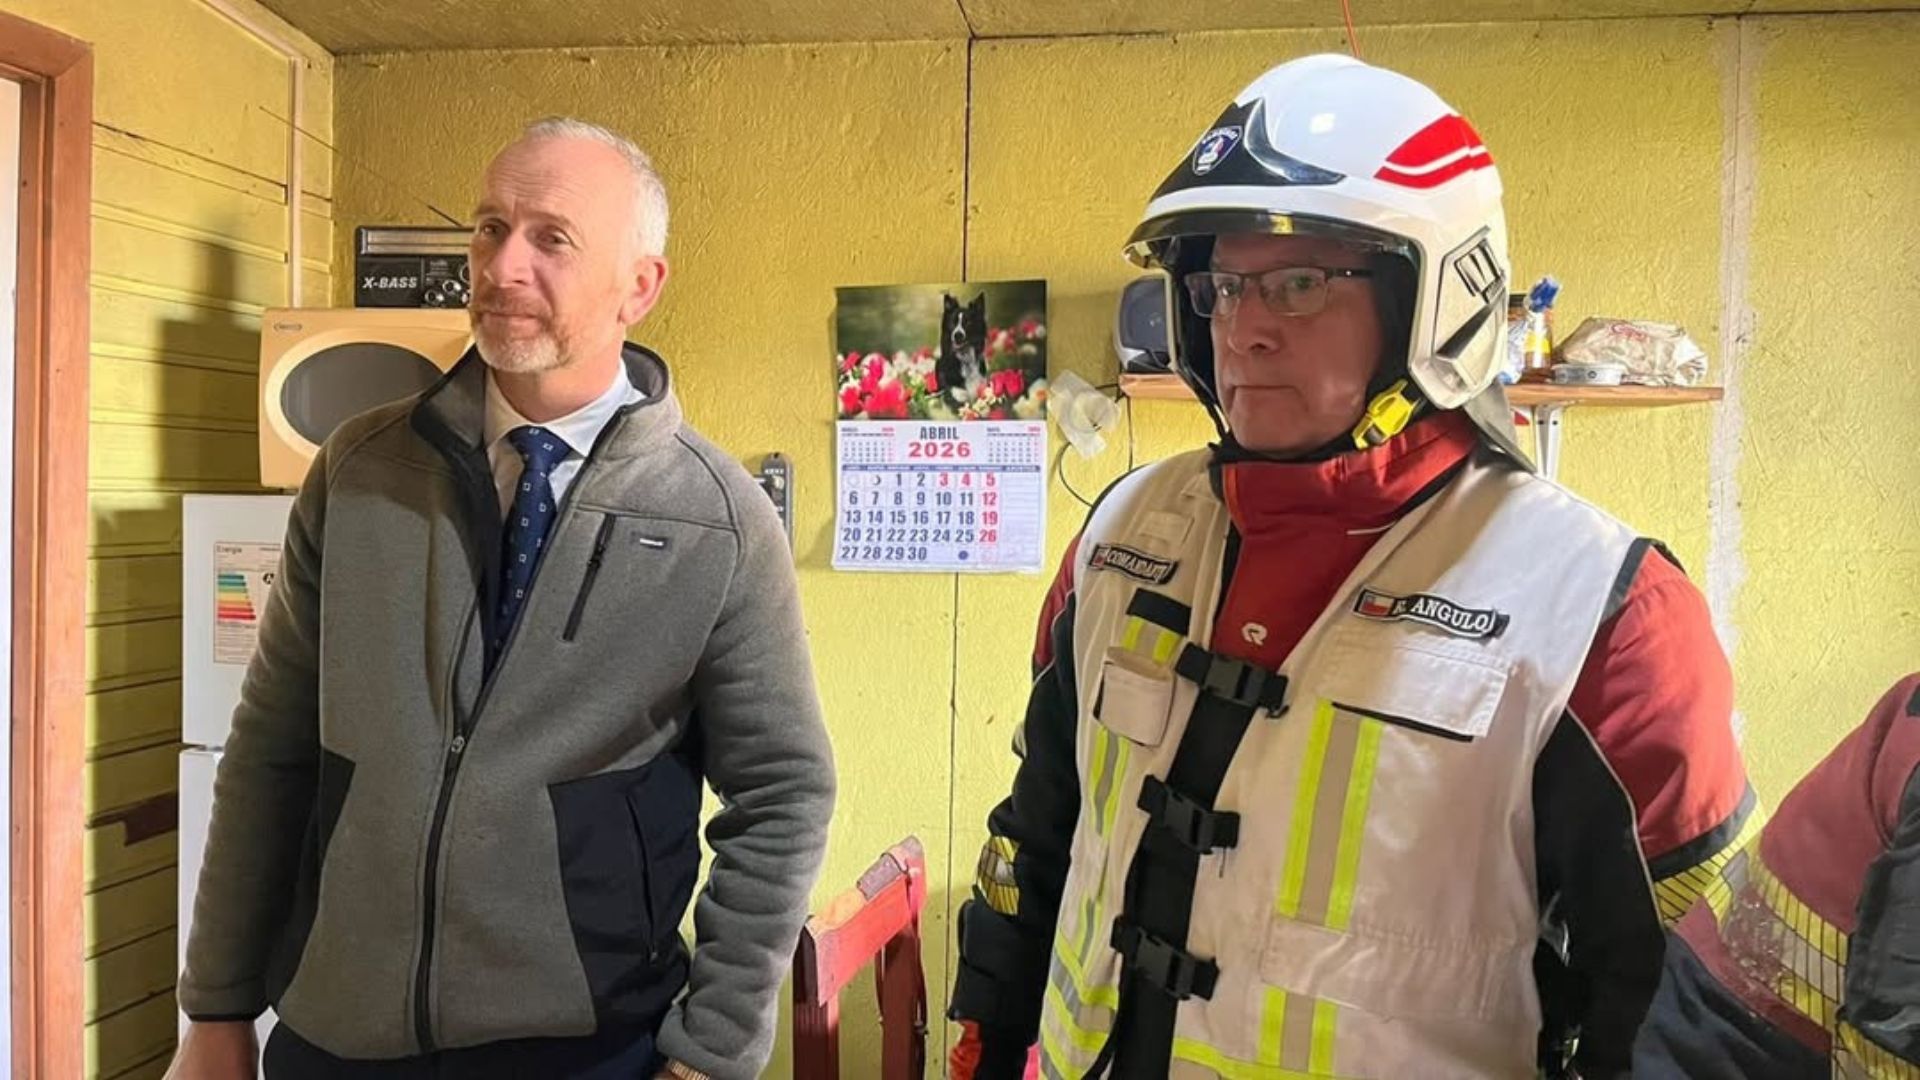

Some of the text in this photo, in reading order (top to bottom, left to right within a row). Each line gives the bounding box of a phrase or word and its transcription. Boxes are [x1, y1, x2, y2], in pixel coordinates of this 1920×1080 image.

[362, 276, 418, 289] X-BASS
[919, 426, 960, 440] ABRIL
[908, 442, 971, 458] 2026
[896, 473, 996, 486] 1 2 3 4 5
[849, 492, 997, 505] 6 7 8 9 10 11 12
[846, 511, 998, 525] 13 14 15 16 17 18 19
[842, 528, 997, 542] 20 21 22 23 24 25 26
[841, 547, 928, 560] 27 28 29 30
[1410, 598, 1489, 631] ANGULO
